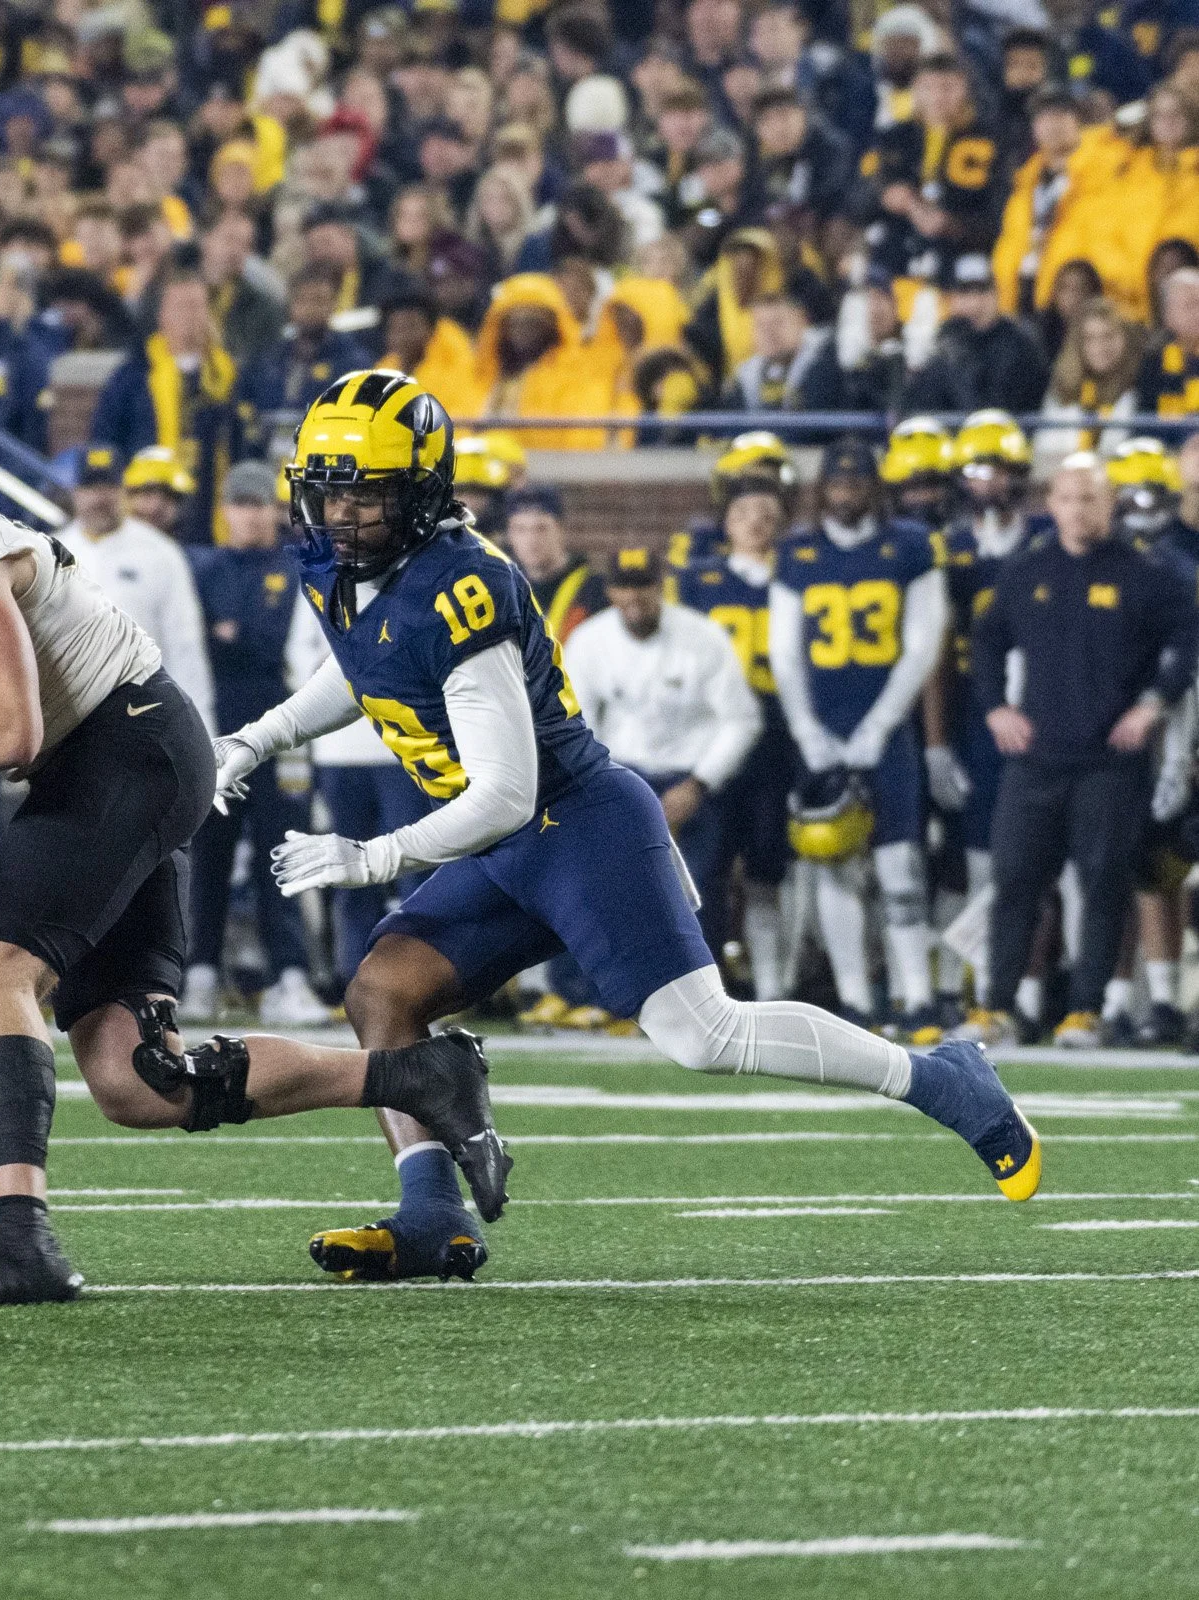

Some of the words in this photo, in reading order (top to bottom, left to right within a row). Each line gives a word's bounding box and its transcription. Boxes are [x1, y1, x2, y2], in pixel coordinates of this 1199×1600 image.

[324, 455, 338, 467] M
[434, 574, 496, 646] 18
[804, 579, 900, 669] 33
[995, 1153, 1014, 1172] M
